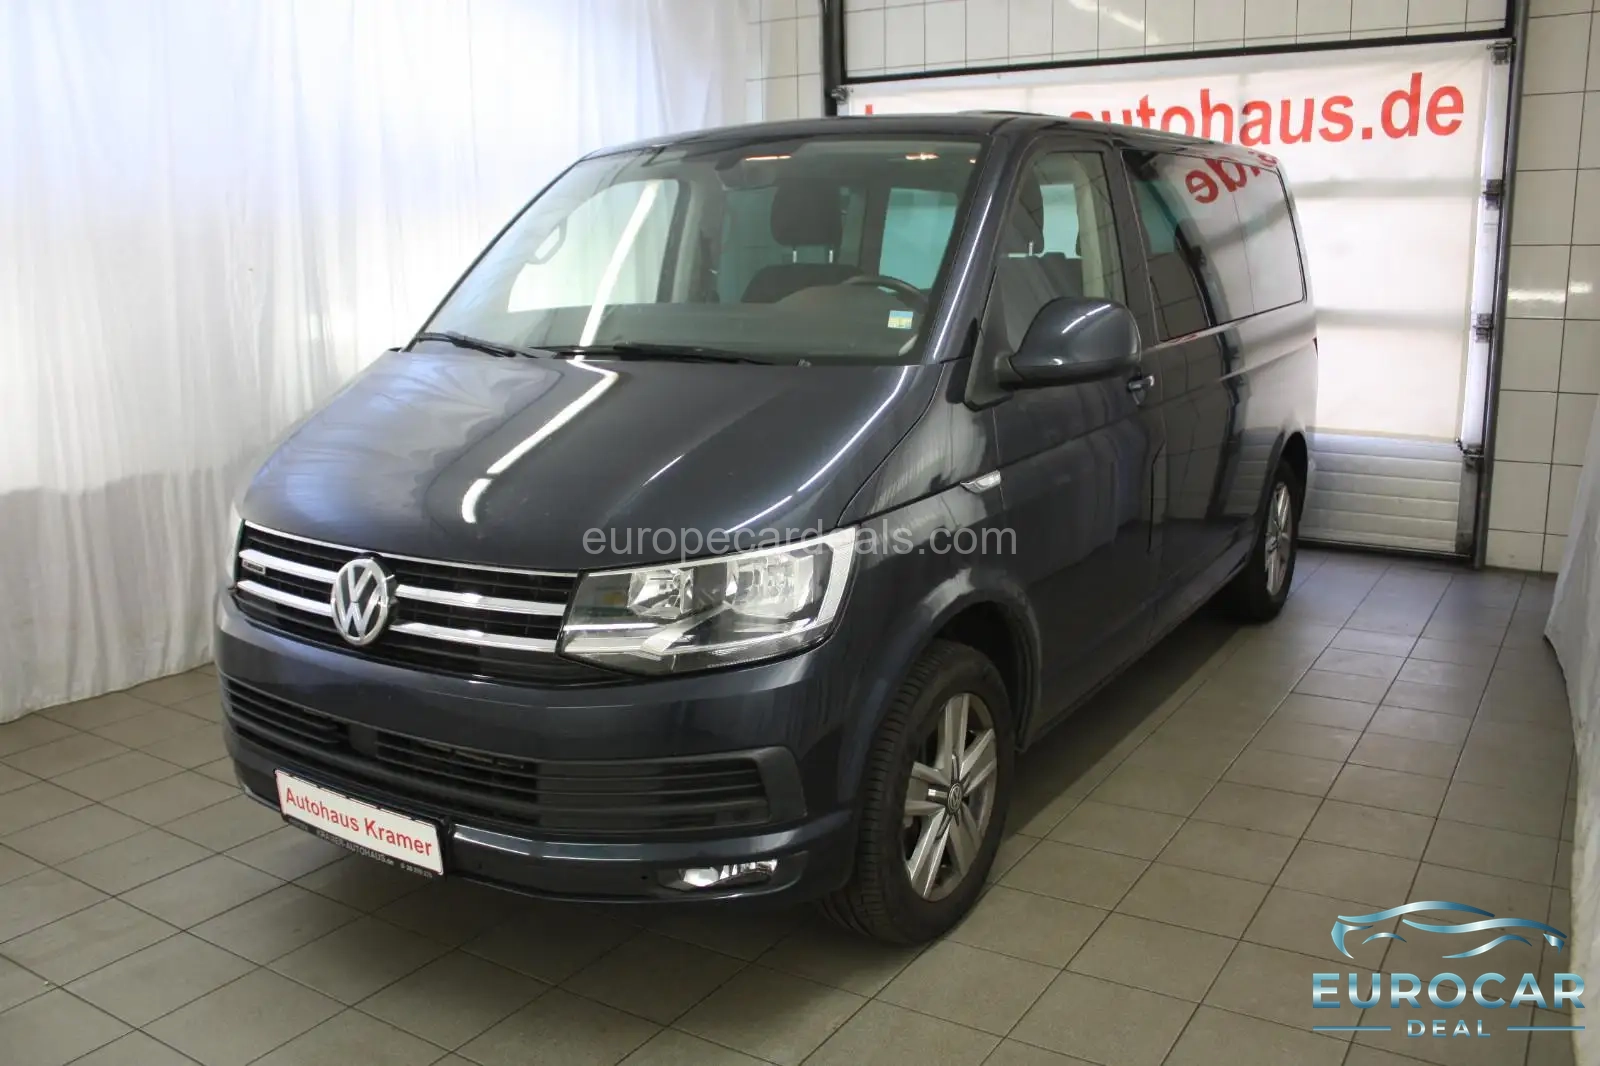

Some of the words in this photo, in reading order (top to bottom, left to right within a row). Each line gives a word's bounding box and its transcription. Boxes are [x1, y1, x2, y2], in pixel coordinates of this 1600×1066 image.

[1070, 72, 1465, 147] tohaus.de
[286, 787, 360, 832] Autohaus
[364, 817, 433, 857] Kramer
